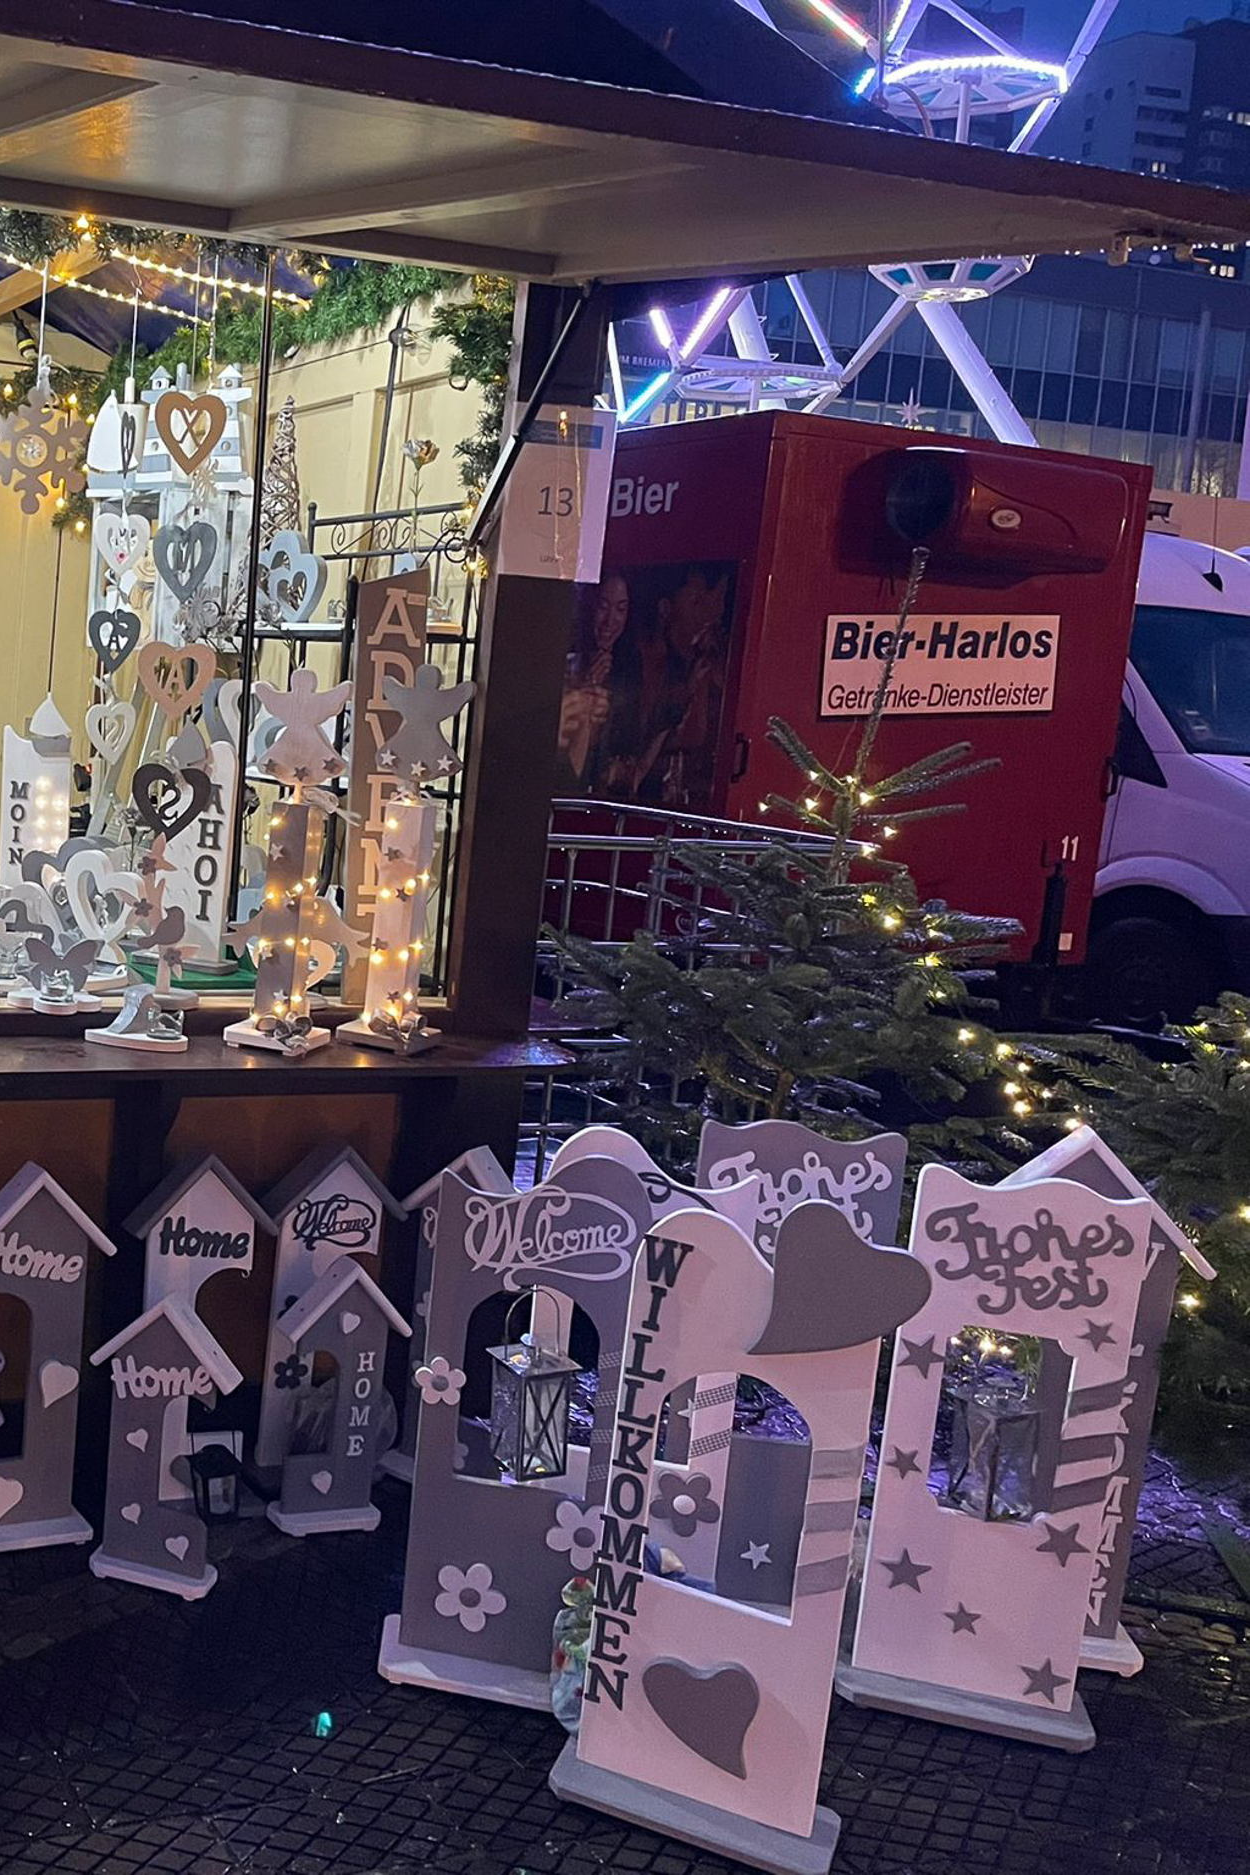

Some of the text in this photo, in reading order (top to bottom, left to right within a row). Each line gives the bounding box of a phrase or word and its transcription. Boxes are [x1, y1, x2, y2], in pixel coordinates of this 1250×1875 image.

[537, 486, 574, 517] 13
[611, 477, 680, 518] Bier
[831, 621, 1053, 660] Bier-Harlos
[8, 780, 31, 866] MOIN
[1061, 835, 1080, 862] 11
[193, 783, 226, 922] AHOI
[158, 1215, 251, 1259] Home
[292, 1193, 377, 1251] Welcome
[463, 1184, 638, 1292] Welcome
[926, 1202, 1135, 1281] Frohes
[977, 1264, 1109, 1315] Fest
[109, 1355, 214, 1400] Home
[346, 1351, 377, 1457] HOME
[584, 1231, 695, 1713] WILLKOMMEN
